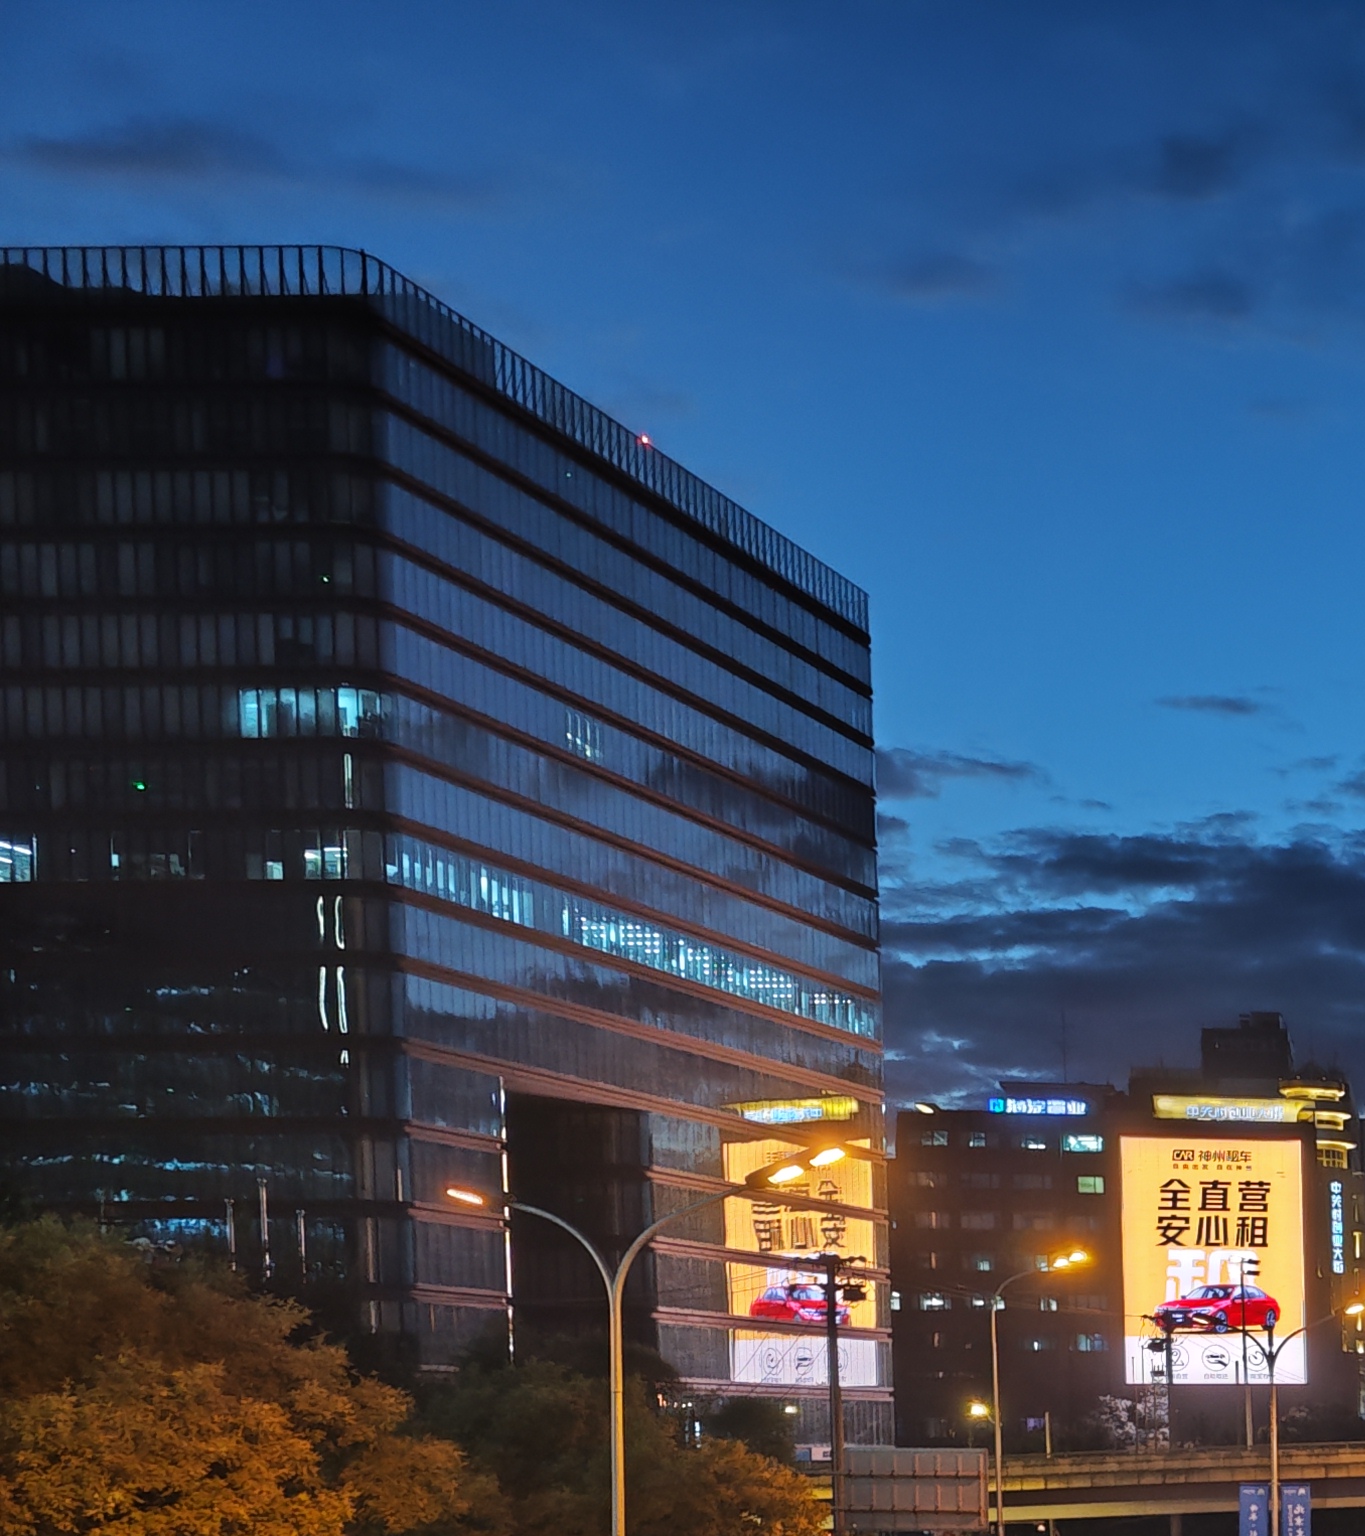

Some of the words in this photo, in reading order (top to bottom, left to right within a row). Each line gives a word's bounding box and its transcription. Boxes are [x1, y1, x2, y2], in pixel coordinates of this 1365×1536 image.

[1173, 1150, 1194, 1161] CAR
[1198, 1150, 1252, 1162] 神州租车
[1157, 1178, 1272, 1213] 全直营
[1155, 1214, 1269, 1248] 安心租
